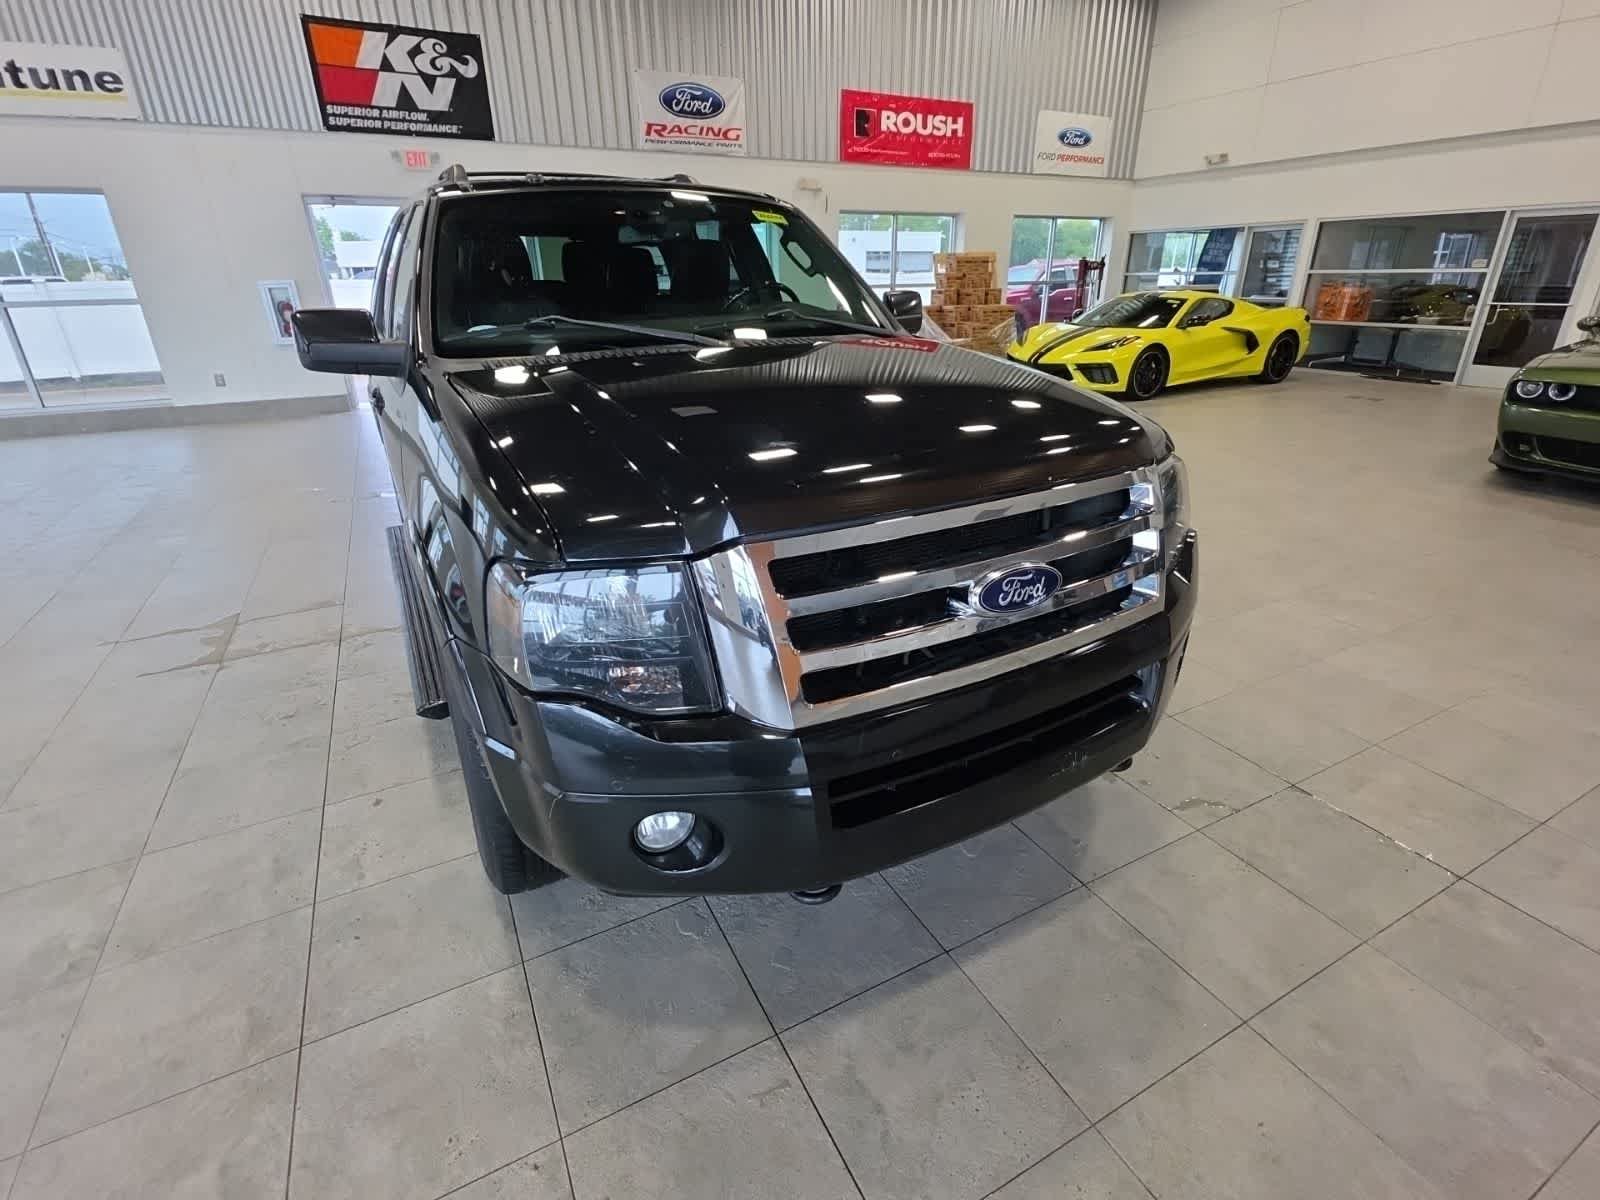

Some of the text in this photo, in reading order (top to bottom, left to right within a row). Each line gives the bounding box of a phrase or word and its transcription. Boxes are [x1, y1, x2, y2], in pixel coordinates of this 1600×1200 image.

[0, 58, 124, 94] tune
[672, 88, 713, 114] Ford
[326, 105, 430, 121] SUPERIOR AIRFLOW.
[329, 116, 382, 129] SUPERIOR
[645, 122, 743, 141] RACING
[880, 110, 964, 137] ROUSH
[1063, 131, 1086, 145] Ford
[406, 151, 428, 168] EXIT
[1037, 152, 1056, 161] FORD
[998, 573, 1046, 607] Ford
